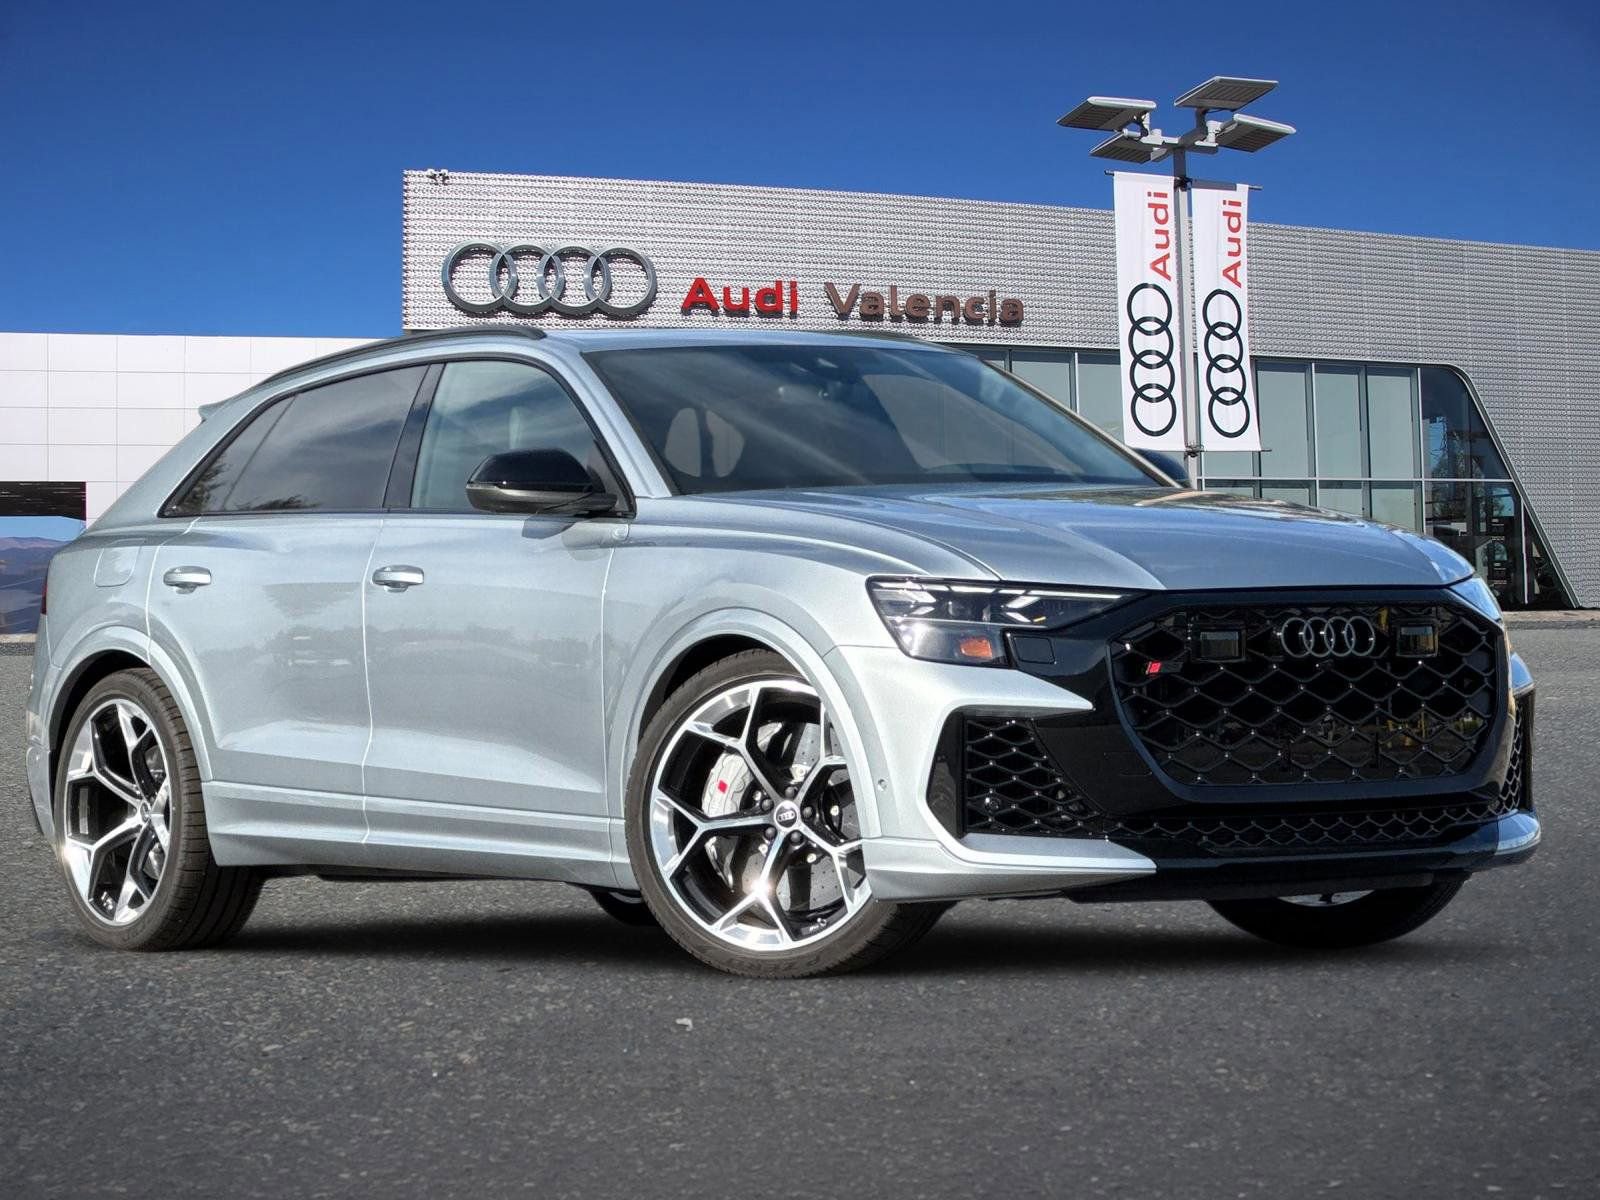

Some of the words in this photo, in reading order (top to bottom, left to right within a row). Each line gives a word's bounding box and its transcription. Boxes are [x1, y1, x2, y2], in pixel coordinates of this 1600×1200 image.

[1147, 191, 1172, 282] Audi
[1222, 199, 1242, 289] Audi
[681, 277, 799, 317] Audi
[824, 282, 1025, 325] Valencia
